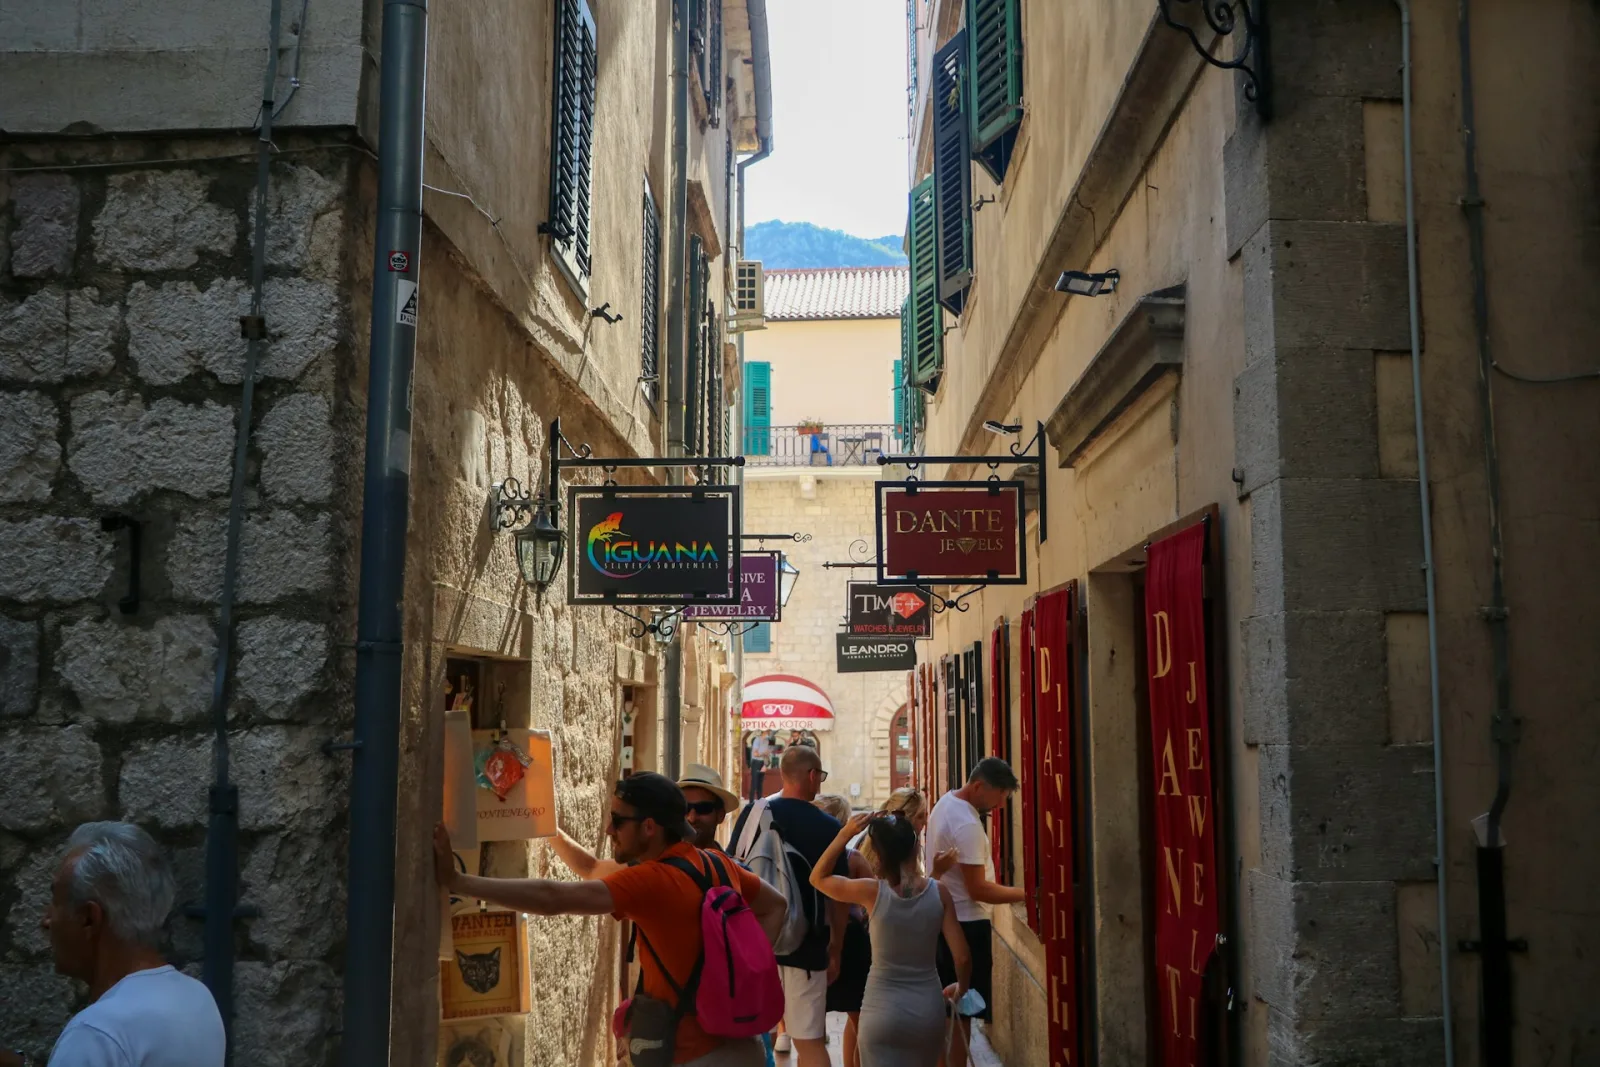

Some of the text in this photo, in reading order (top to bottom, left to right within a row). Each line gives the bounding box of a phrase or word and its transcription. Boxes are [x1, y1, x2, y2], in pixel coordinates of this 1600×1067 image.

[894, 509, 1004, 533] DANTE
[604, 540, 719, 563] IGUANA
[604, 562, 642, 570] SILVER
[657, 562, 719, 570] SOUVENIRS
[691, 605, 767, 616] JEWELRY
[853, 624, 927, 633] WATCHES & JEWELRY
[841, 643, 909, 656] LEANDRO
[740, 720, 814, 729] OPTIKA KOTOR
[477, 806, 546, 819] ONTENEGRO
